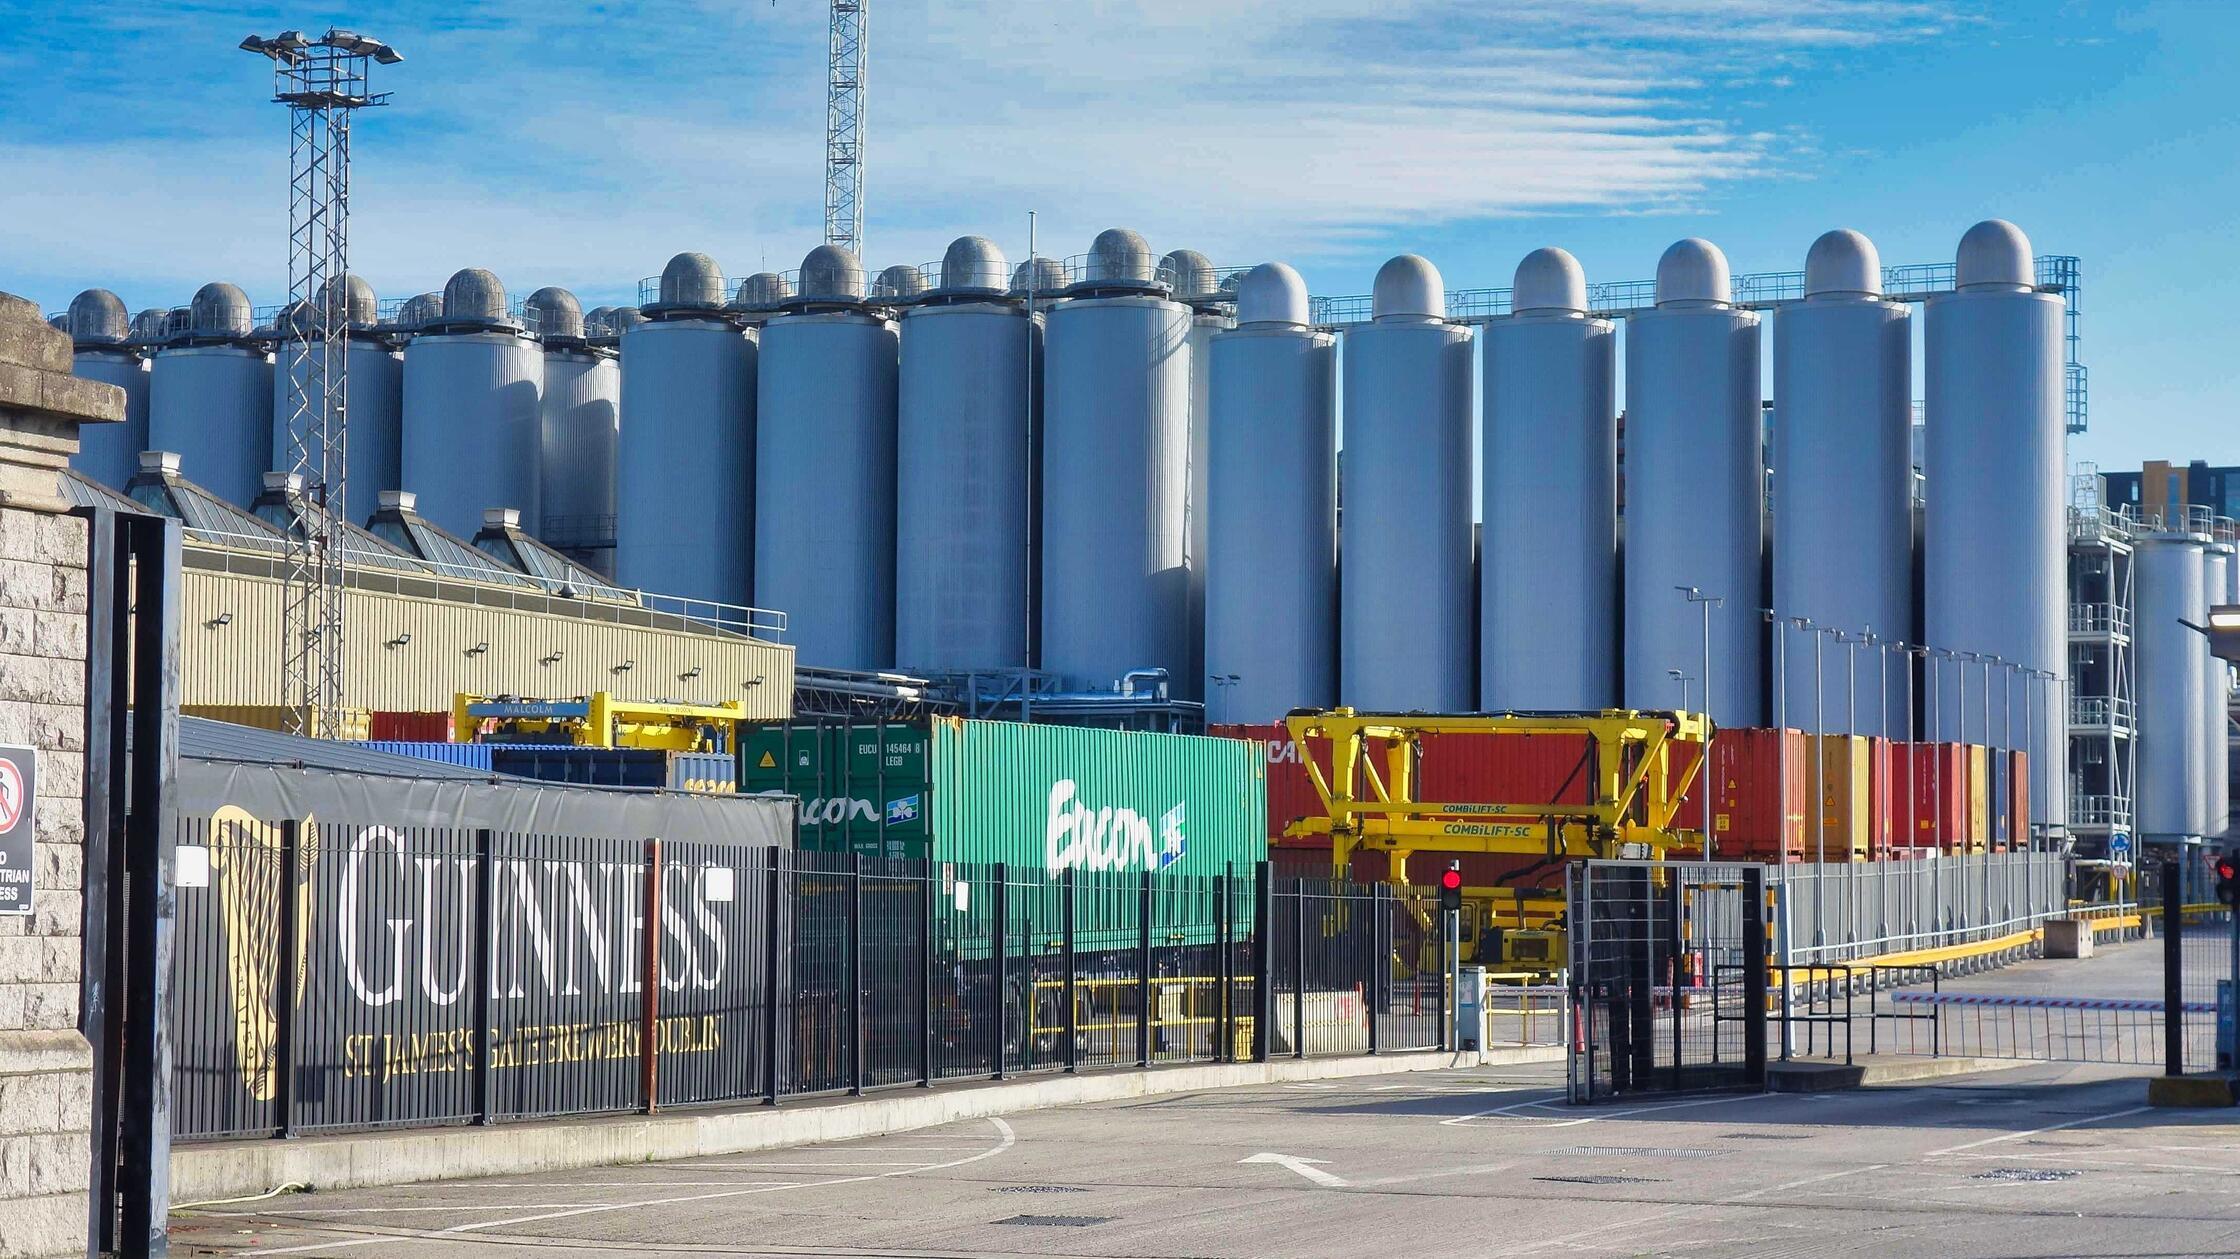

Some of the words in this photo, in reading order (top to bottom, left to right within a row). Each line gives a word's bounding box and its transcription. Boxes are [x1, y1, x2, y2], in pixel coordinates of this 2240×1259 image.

[503, 705, 553, 715] MALCOLM
[858, 743, 877, 755] EUCU
[886, 743, 912, 754] 145464
[1047, 778, 1157, 880] Eucon
[338, 824, 727, 1006] GUINNESS
[544, 1020, 641, 1064] BREWERY
